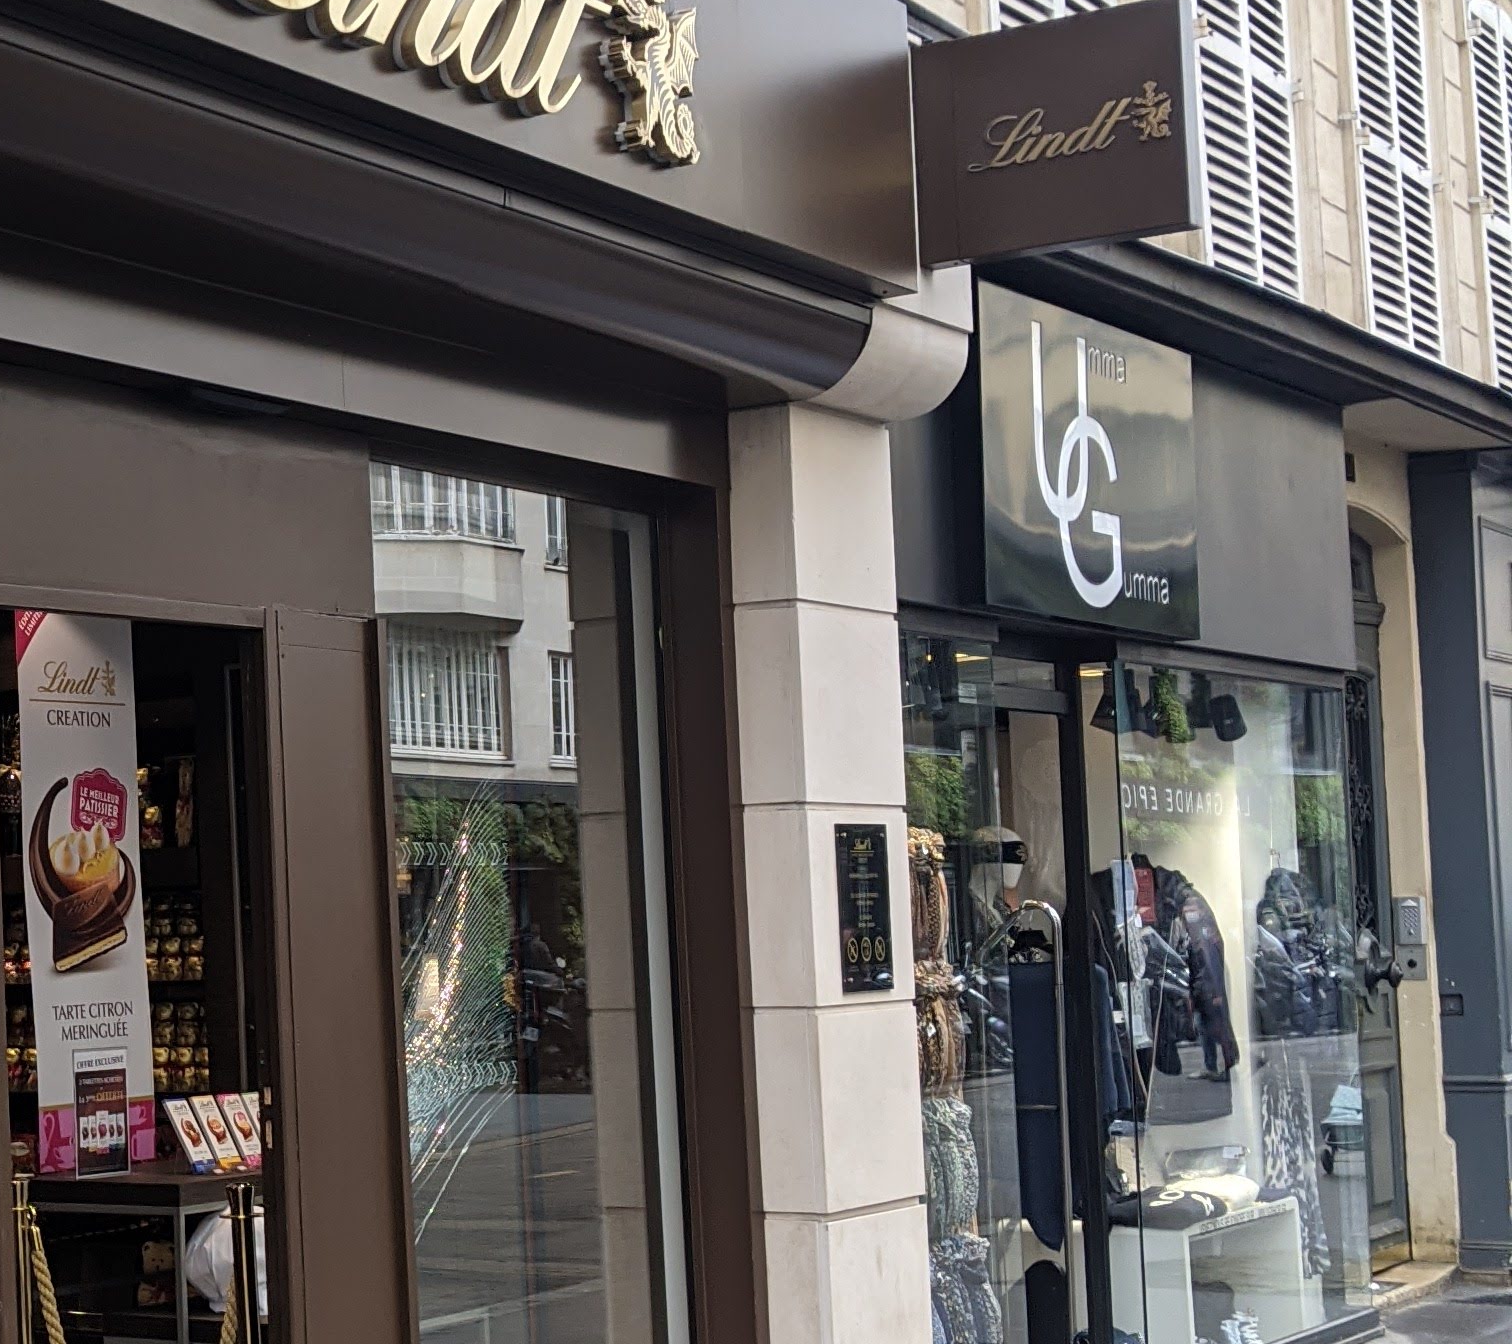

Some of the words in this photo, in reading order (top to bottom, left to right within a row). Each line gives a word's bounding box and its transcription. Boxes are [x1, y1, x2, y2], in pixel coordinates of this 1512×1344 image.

[967, 97, 1131, 172] Lindt
[37, 660, 100, 695] Lindt
[46, 709, 111, 728] CREATION
[52, 1004, 86, 1021] TARTE
[88, 1000, 133, 1020] CITRON
[61, 1018, 128, 1041] MERINGUÉE
